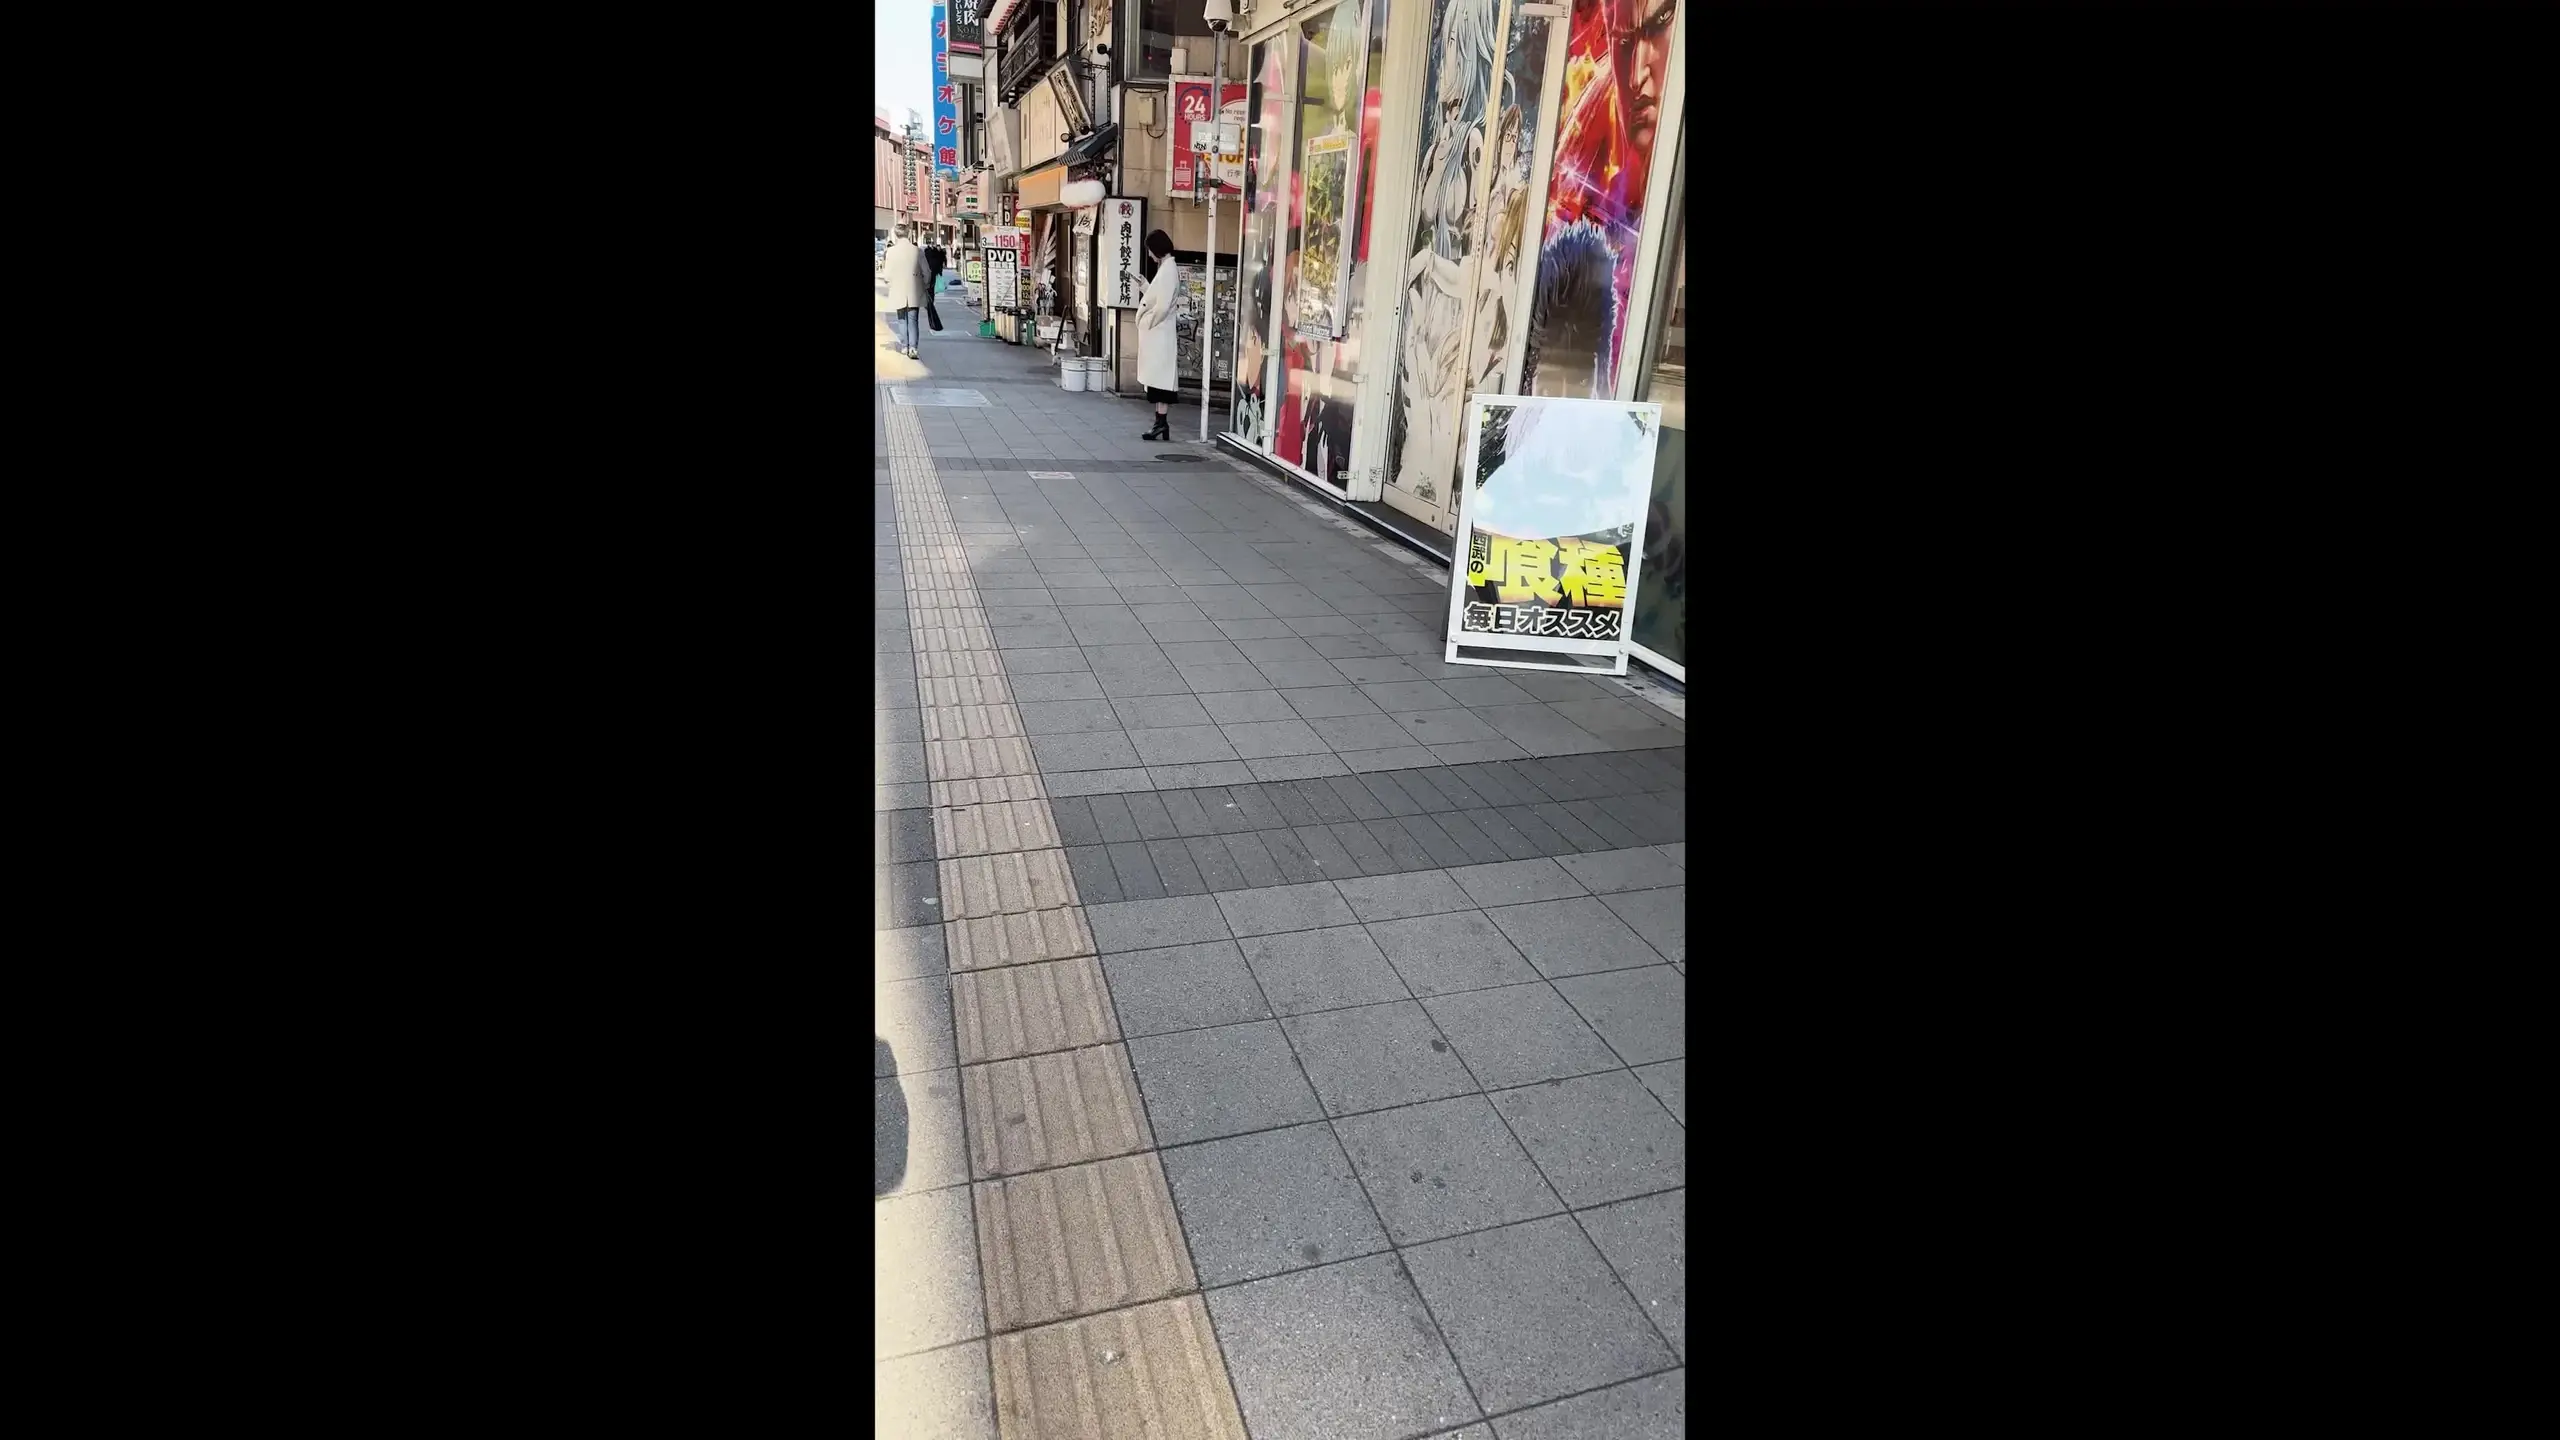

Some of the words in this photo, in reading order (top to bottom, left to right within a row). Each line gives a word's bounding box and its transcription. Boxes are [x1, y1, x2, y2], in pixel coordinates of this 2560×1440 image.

[1185, 96, 1206, 114] 24
[995, 234, 1016, 247] 1150
[987, 249, 1015, 262] DVD
[1119, 221, 1132, 306] 肉汁餃子製作所
[1464, 602, 1620, 637] 毎日オススメ
